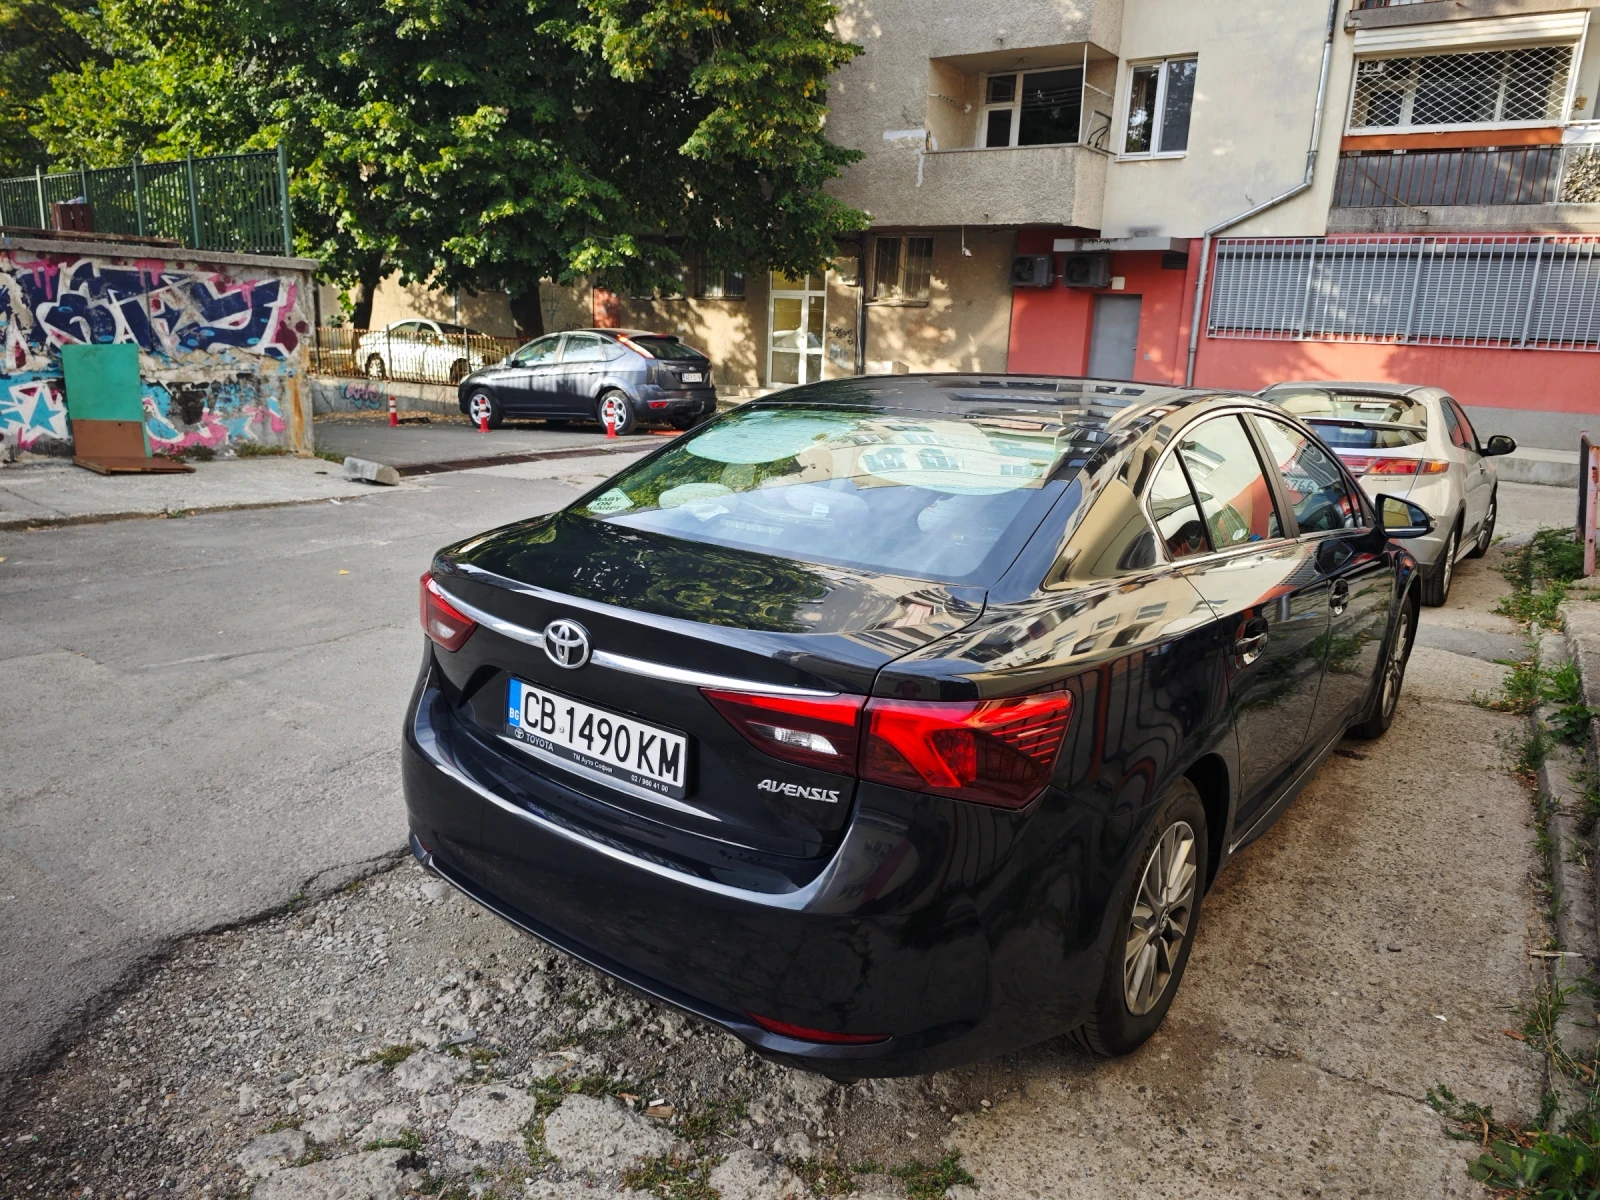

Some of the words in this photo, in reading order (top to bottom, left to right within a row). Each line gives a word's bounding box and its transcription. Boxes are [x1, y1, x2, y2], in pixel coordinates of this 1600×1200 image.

[509, 706, 520, 721] BG
[526, 733, 554, 752] TOYOTA
[757, 779, 840, 803] AVENSIS
